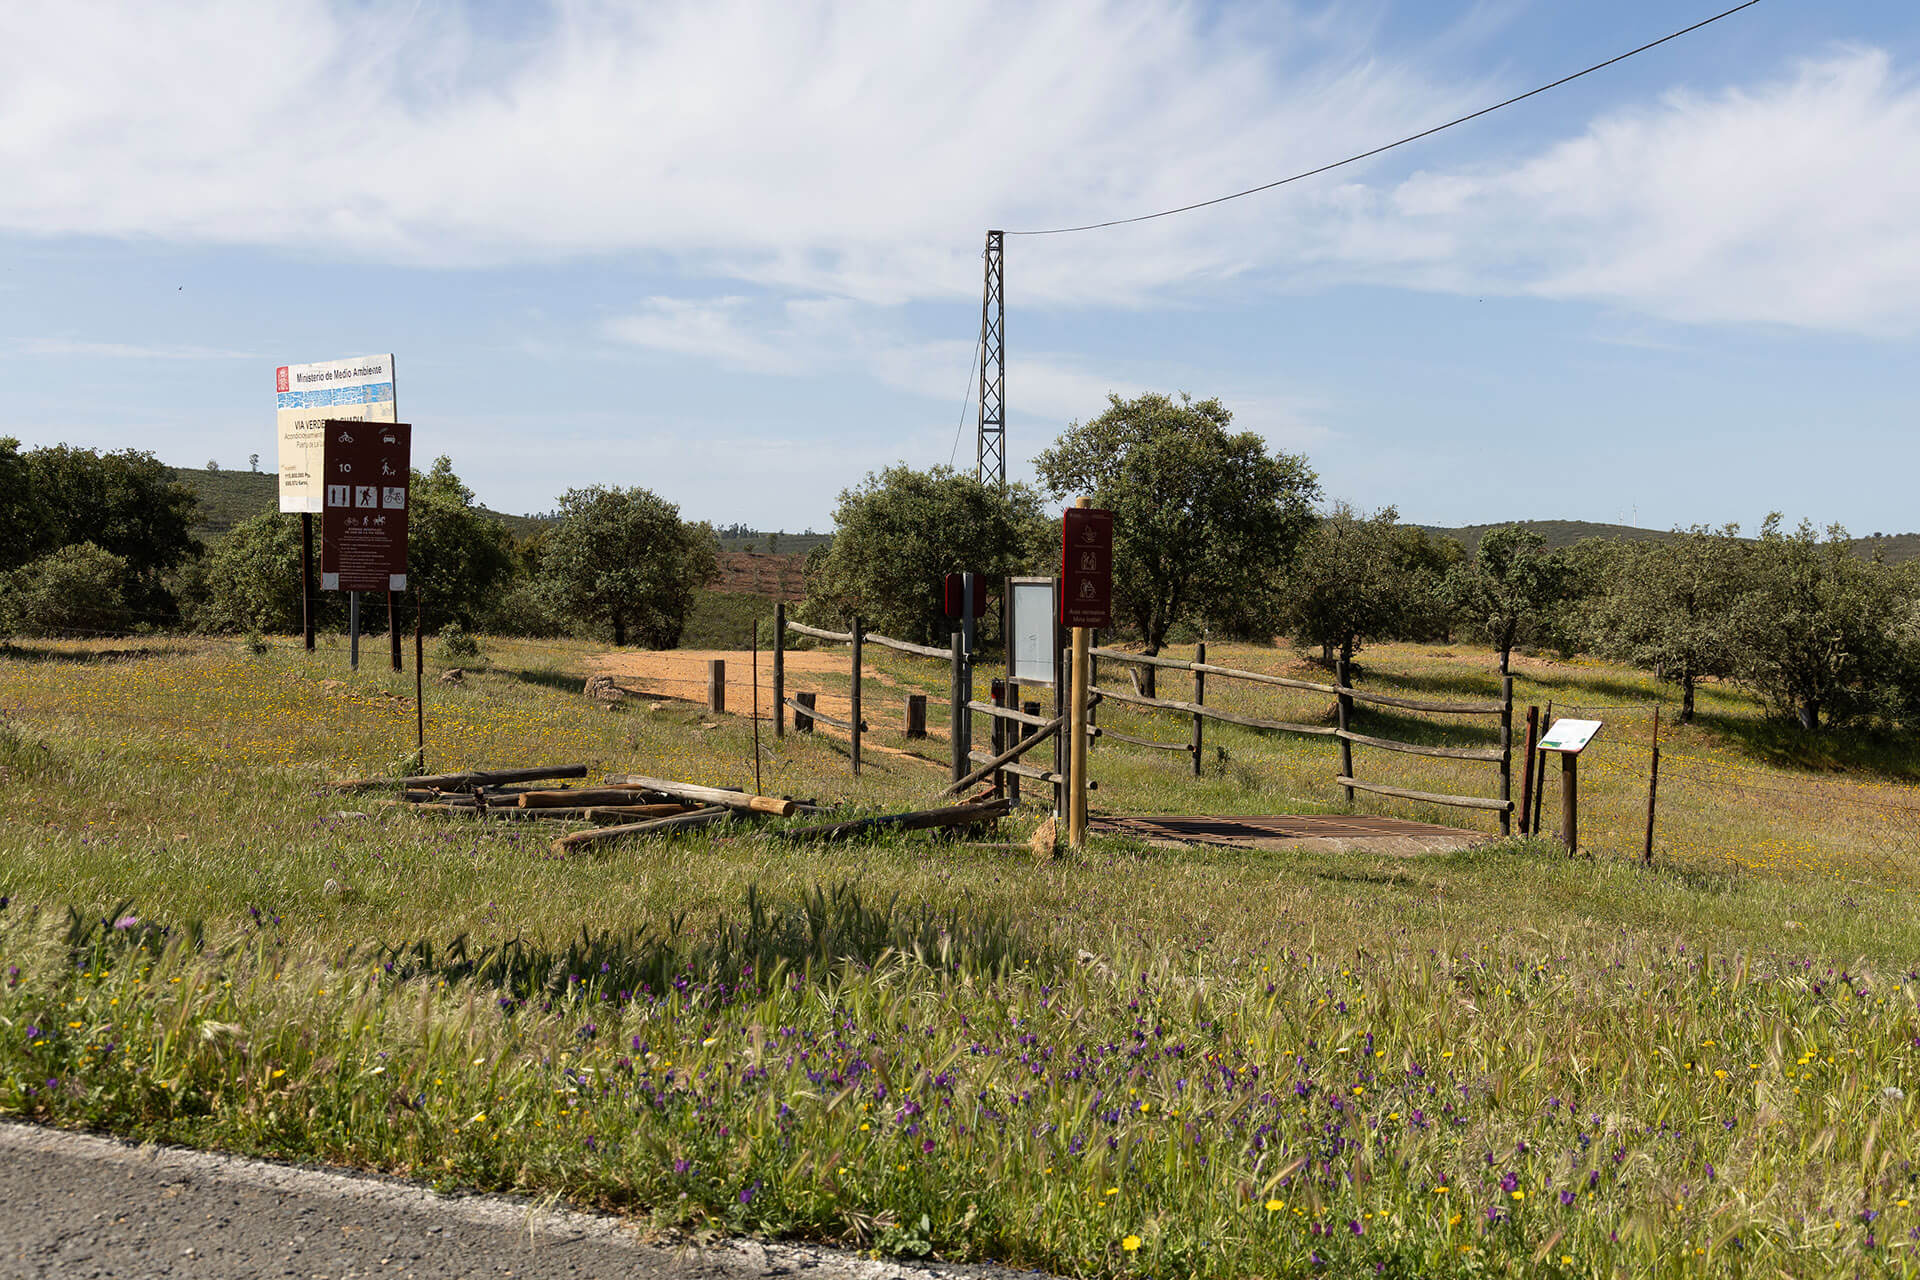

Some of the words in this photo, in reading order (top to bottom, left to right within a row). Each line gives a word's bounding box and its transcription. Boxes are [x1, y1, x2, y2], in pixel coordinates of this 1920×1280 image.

[296, 371, 325, 383] Ministerio
[325, 371, 333, 381] de
[333, 368, 352, 380] Medio
[353, 365, 382, 377] Ambiente
[294, 420, 305, 430] VIA
[306, 419, 326, 430] VERDE
[338, 463, 352, 473] 10
